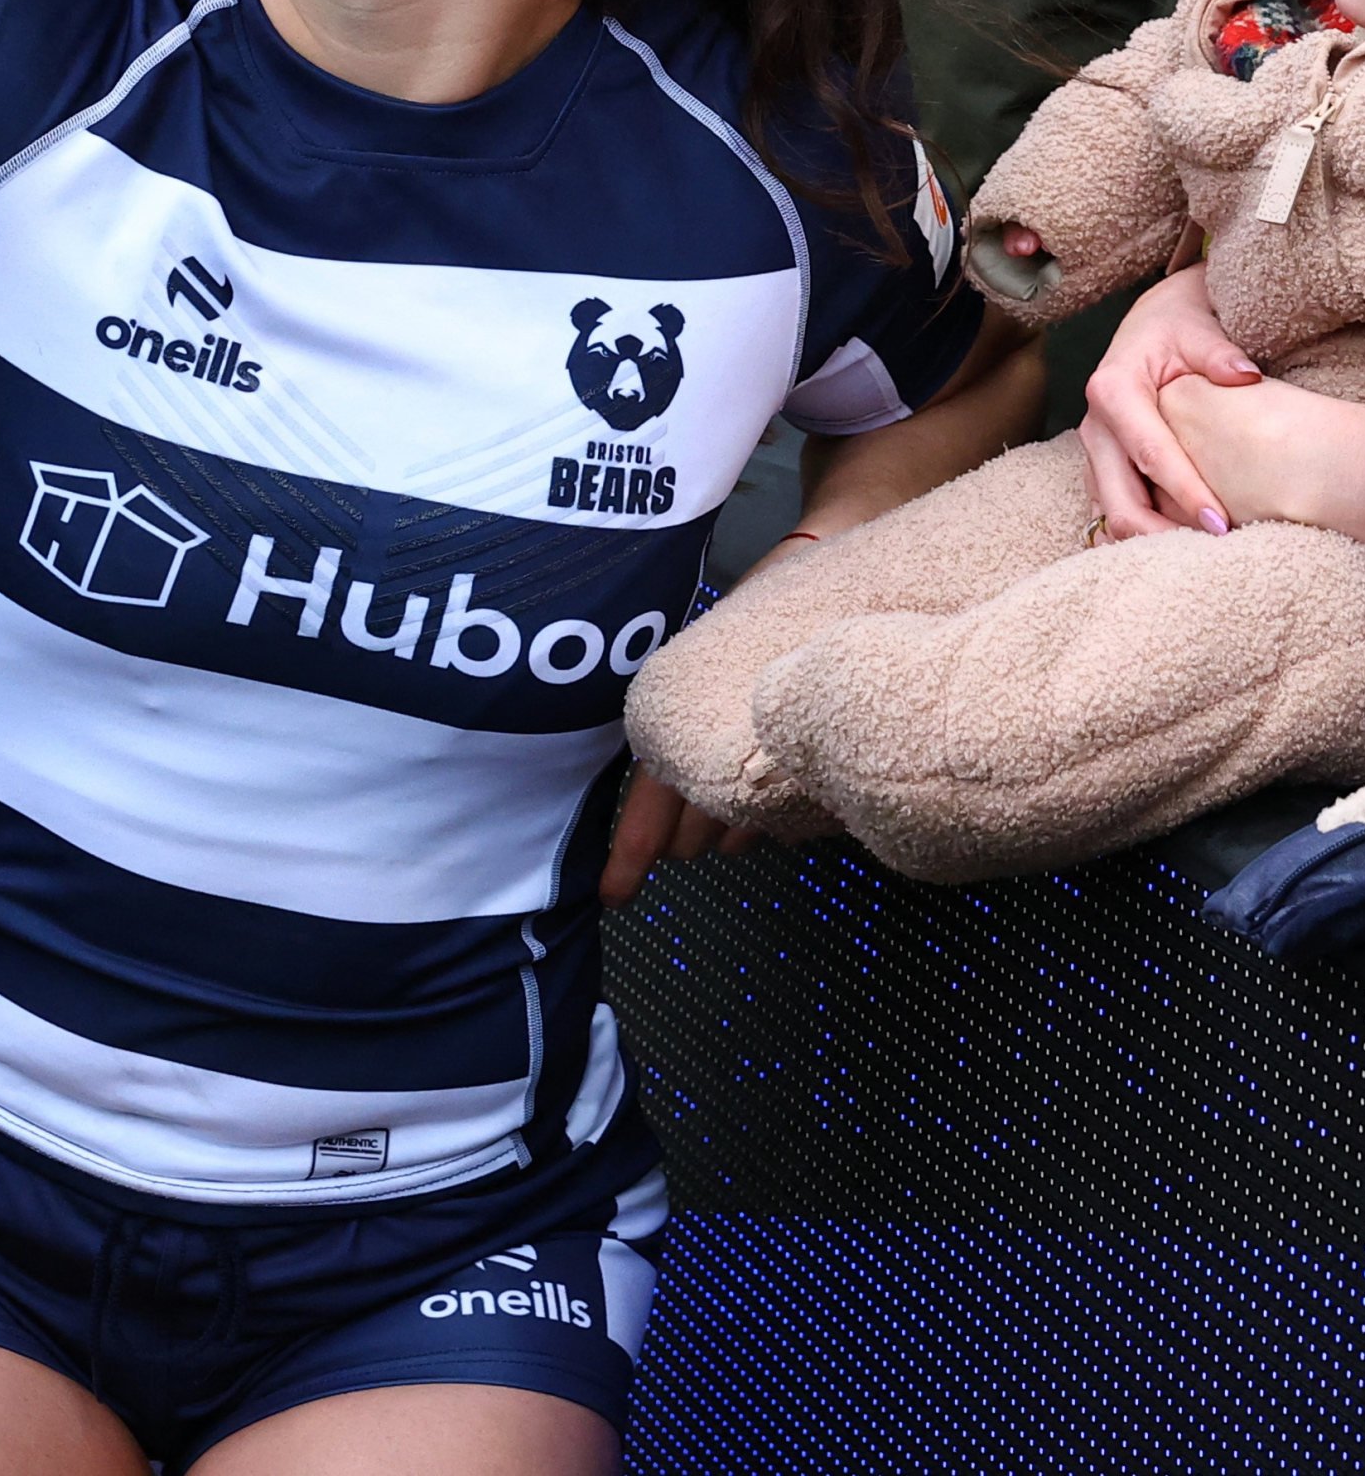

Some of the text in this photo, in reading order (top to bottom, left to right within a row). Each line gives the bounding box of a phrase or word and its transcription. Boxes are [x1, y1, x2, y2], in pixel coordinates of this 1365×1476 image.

[586, 441, 652, 465] BRISTOL
[547, 456, 677, 515] BEARS
[226, 534, 667, 686] Huboo
[322, 1136, 379, 1149] AUTHENTIC
